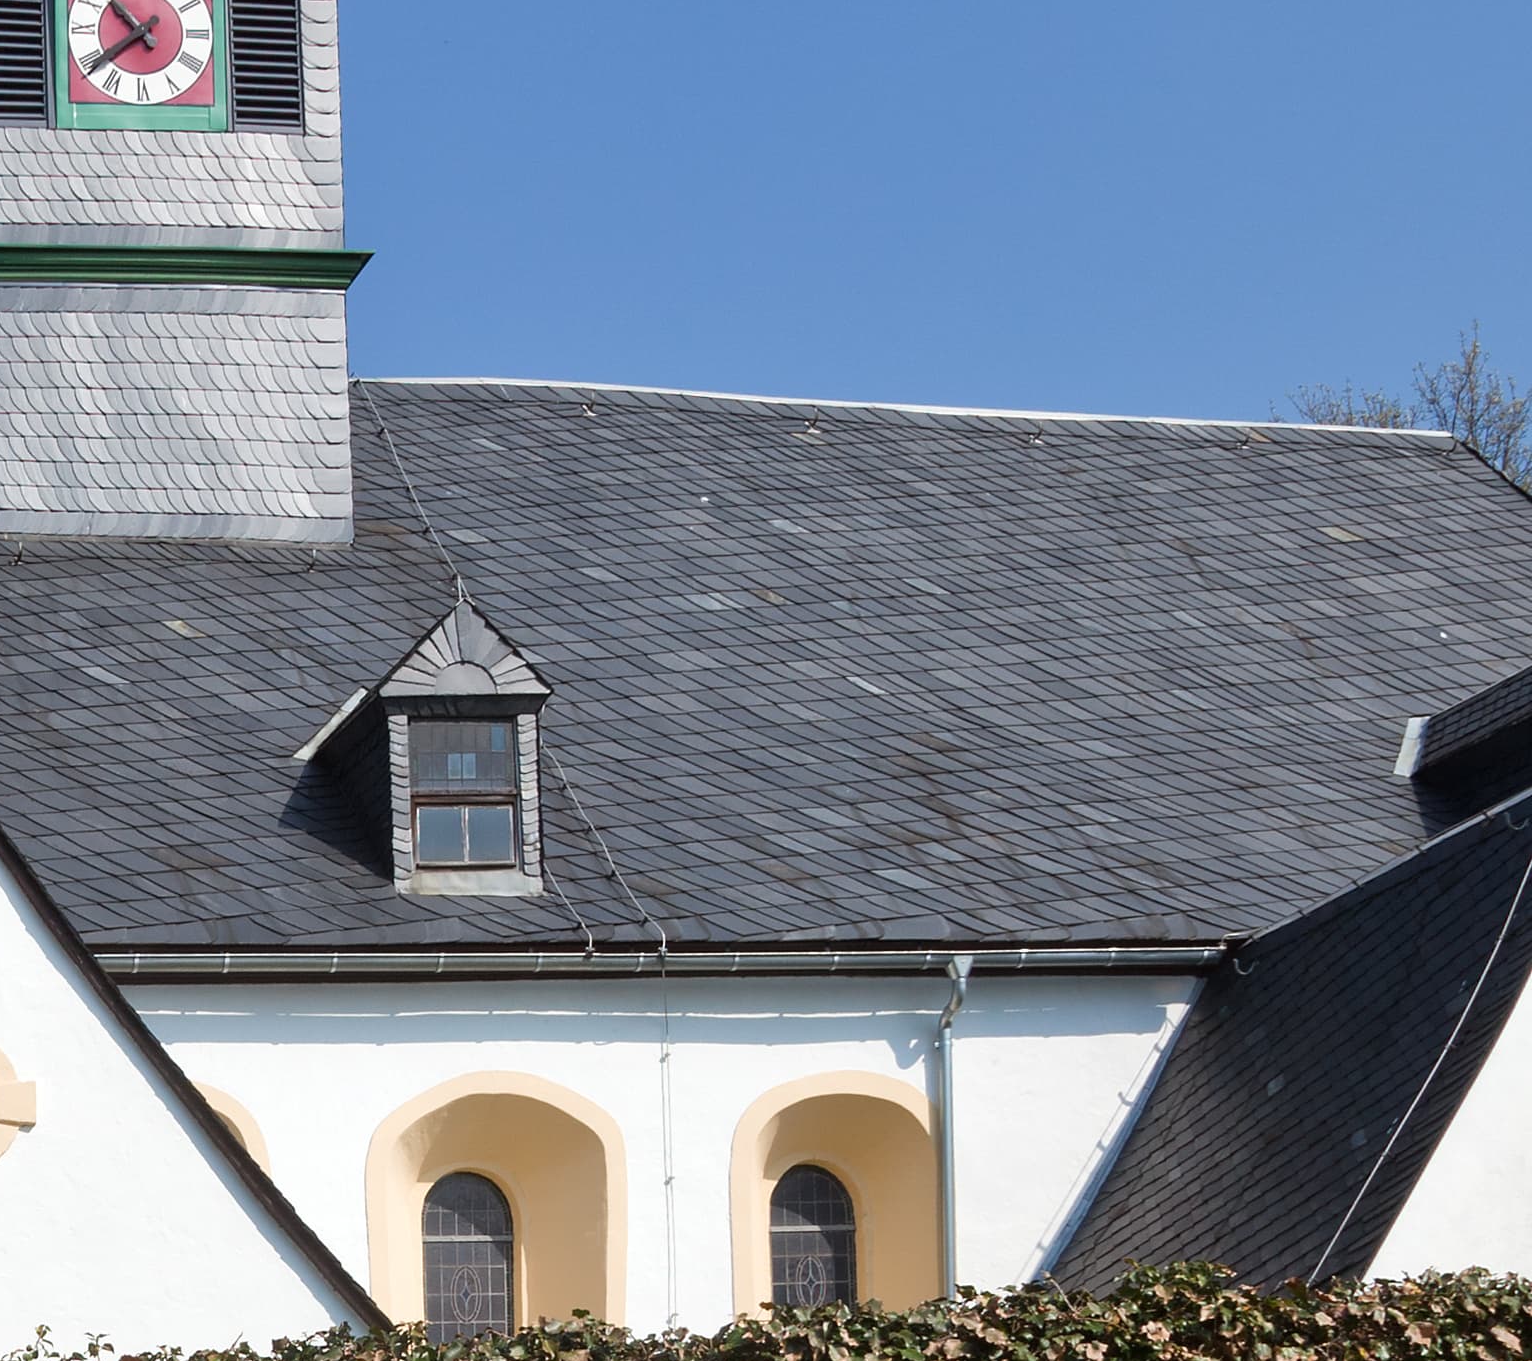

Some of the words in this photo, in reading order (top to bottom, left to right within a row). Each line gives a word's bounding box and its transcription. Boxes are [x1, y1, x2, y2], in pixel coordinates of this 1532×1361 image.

[71, 20, 96, 35] IX
[185, 29, 210, 40] III
[102, 68, 123, 95] VII
[137, 77, 150, 102] VI
[164, 71, 180, 95] V
